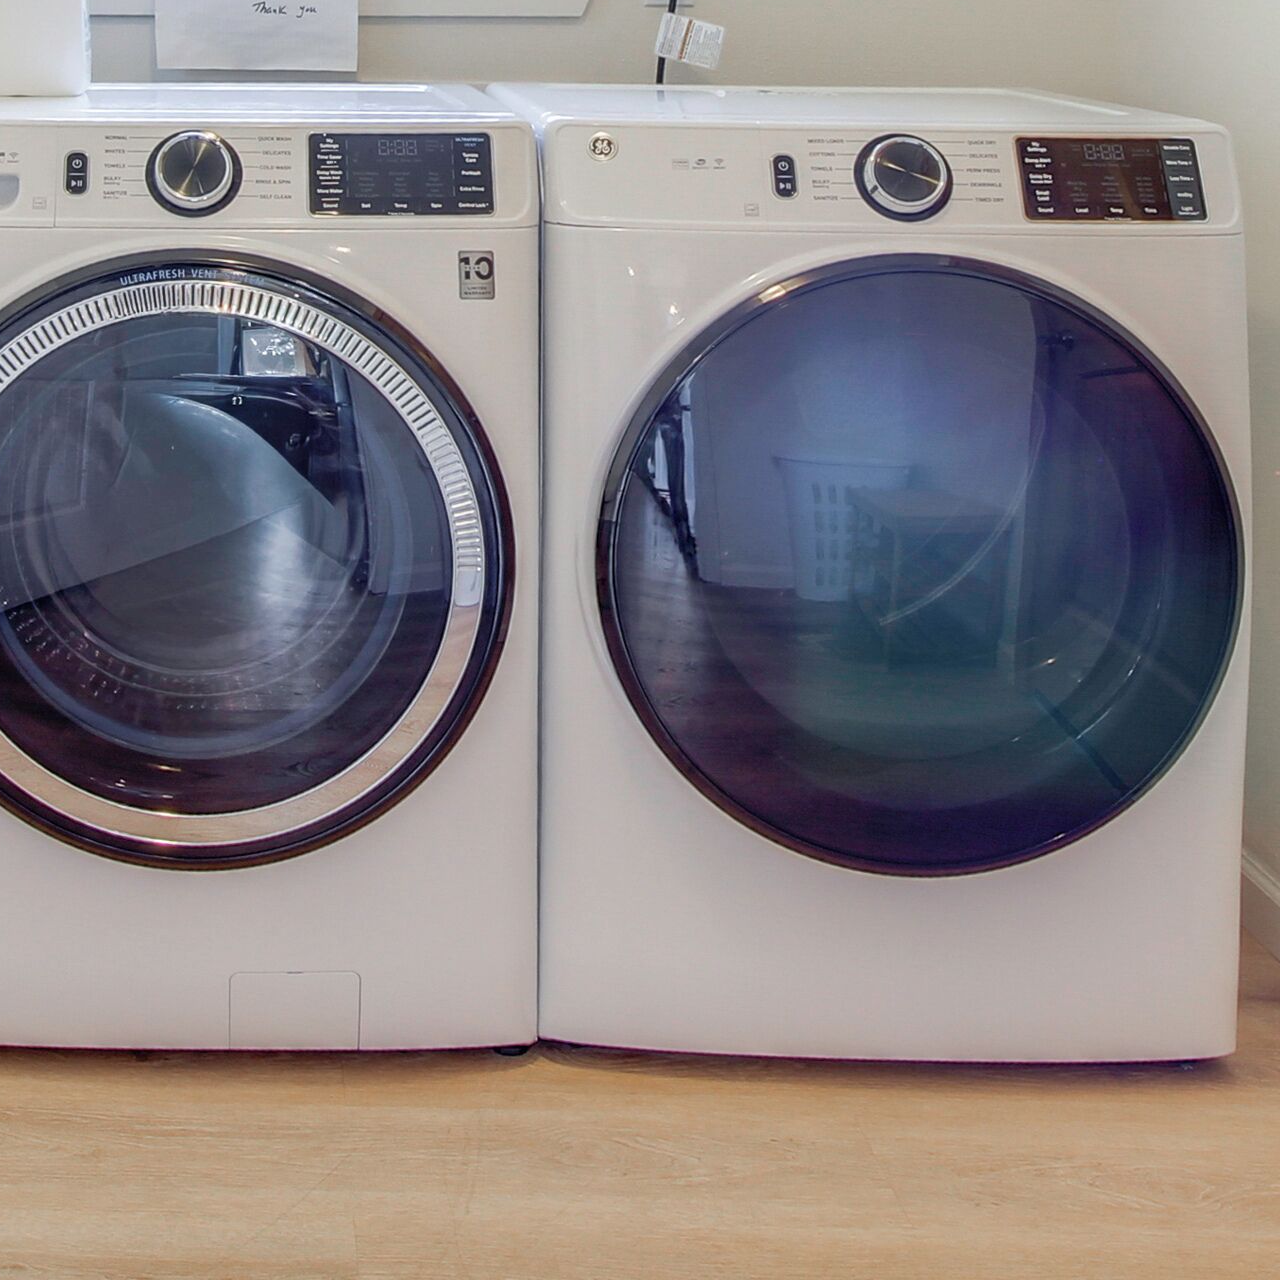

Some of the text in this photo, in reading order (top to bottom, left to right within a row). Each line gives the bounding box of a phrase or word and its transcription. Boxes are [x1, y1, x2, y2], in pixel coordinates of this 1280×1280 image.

[252, 1, 318, 18] Thank you
[460, 256, 494, 280] 10
[120, 269, 185, 286] ULTRAFRESH
[191, 269, 218, 279] VENT
